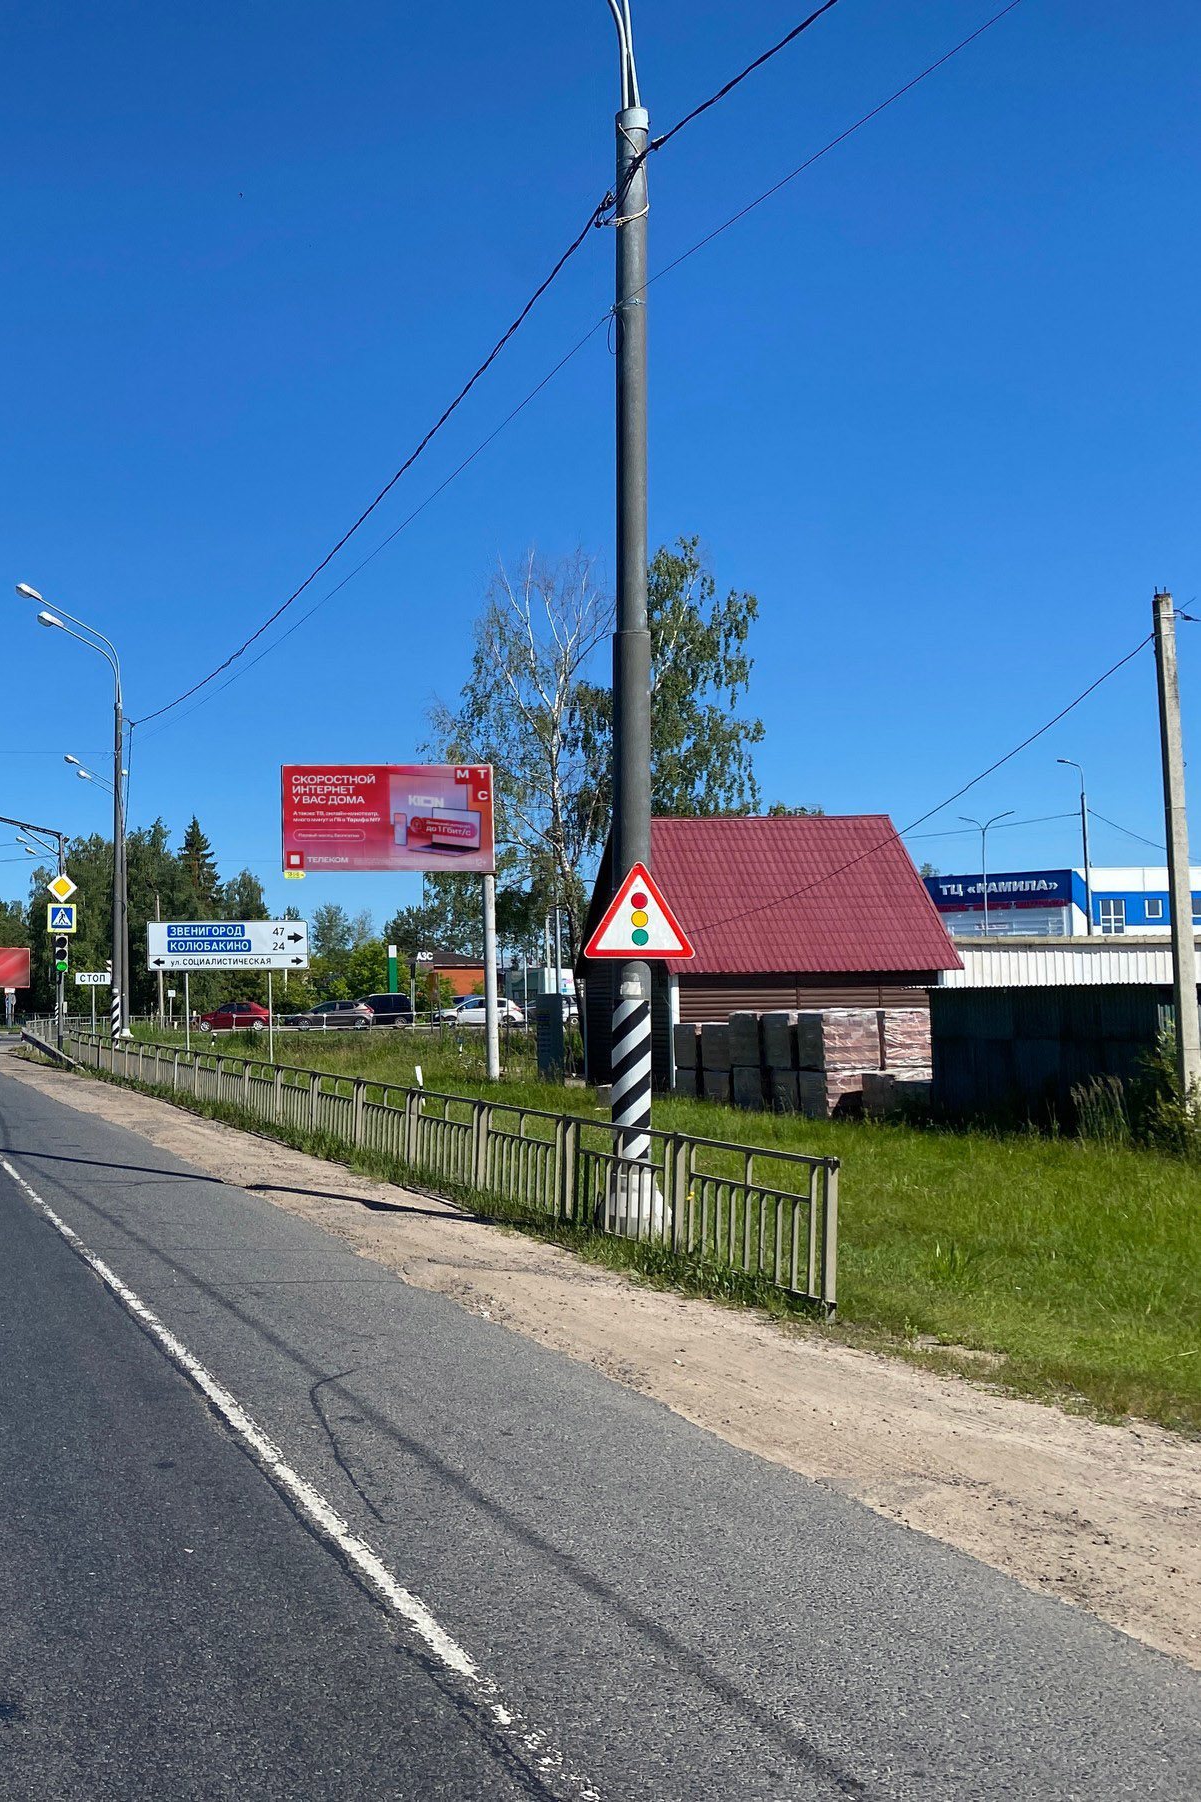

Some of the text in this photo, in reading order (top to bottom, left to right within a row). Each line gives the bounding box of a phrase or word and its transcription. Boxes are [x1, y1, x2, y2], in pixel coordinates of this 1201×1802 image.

[456, 770, 487, 778] М Т
[292, 774, 376, 784] СКОРОСТНОЙ
[292, 785, 355, 794] ИНТЕРНЕТ
[478, 790, 488, 800] С
[292, 796, 365, 805] У ВАС ДОМА
[442, 826, 471, 836] Гбит/с
[939, 879, 1059, 896] ТЦ «КАМИЛА»
[170, 926, 284, 936] ЗВЕНИГОРОД 47
[170, 941, 285, 951] КОЛЮБАКИНО 24
[416, 952, 434, 961] АЗС
[182, 958, 272, 966] СОЦИАЛИСТИЧЕСКАЯ
[80, 974, 106, 983] СТОП
